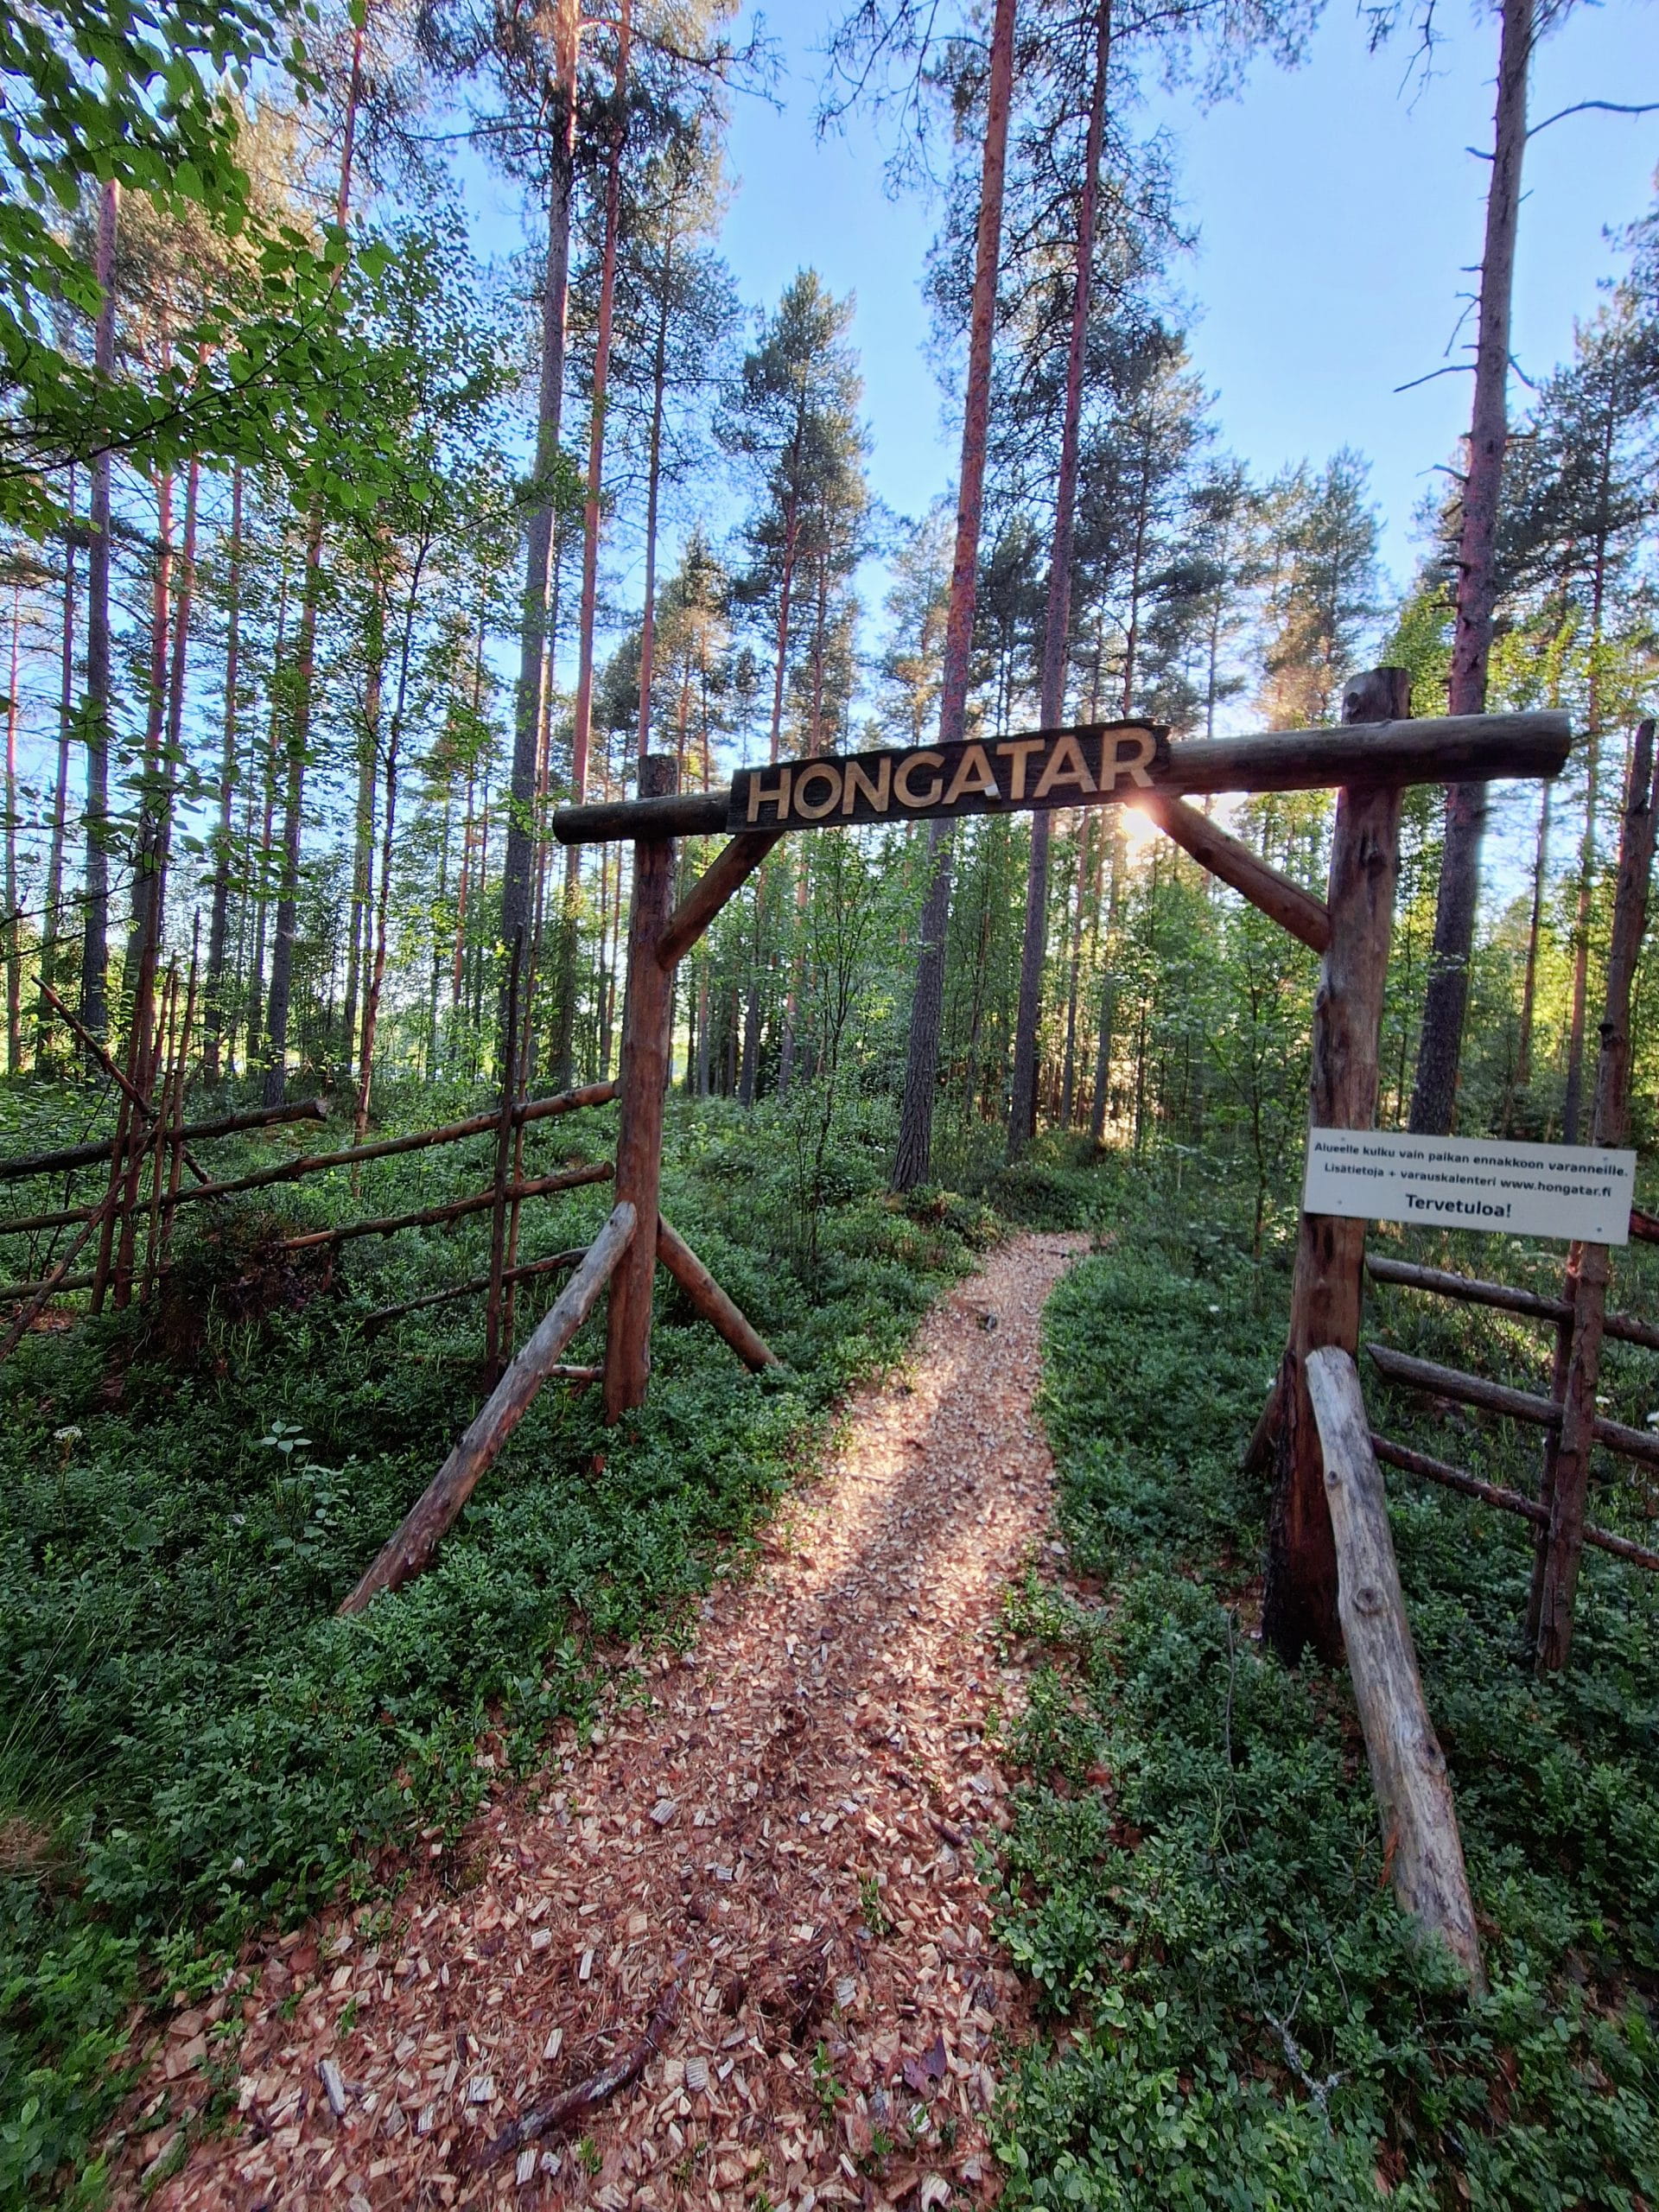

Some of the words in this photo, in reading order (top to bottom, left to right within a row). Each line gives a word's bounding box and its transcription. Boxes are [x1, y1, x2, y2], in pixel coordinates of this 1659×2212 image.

[747, 728, 1158, 823] HONGATAR
[1314, 1142, 1359, 1156] Alueelle
[1363, 1145, 1395, 1158] kulku
[1399, 1148, 1425, 1160] vain
[1428, 1151, 1470, 1165] paikan
[1473, 1154, 1544, 1170] ennakkoon
[1325, 1163, 1384, 1178] Lisätietoja
[1401, 1171, 1497, 1187] varauskalenteri
[1500, 1179, 1611, 1198] www.hongatar.fi
[1405, 1194, 1512, 1218] Tervetuloa!
